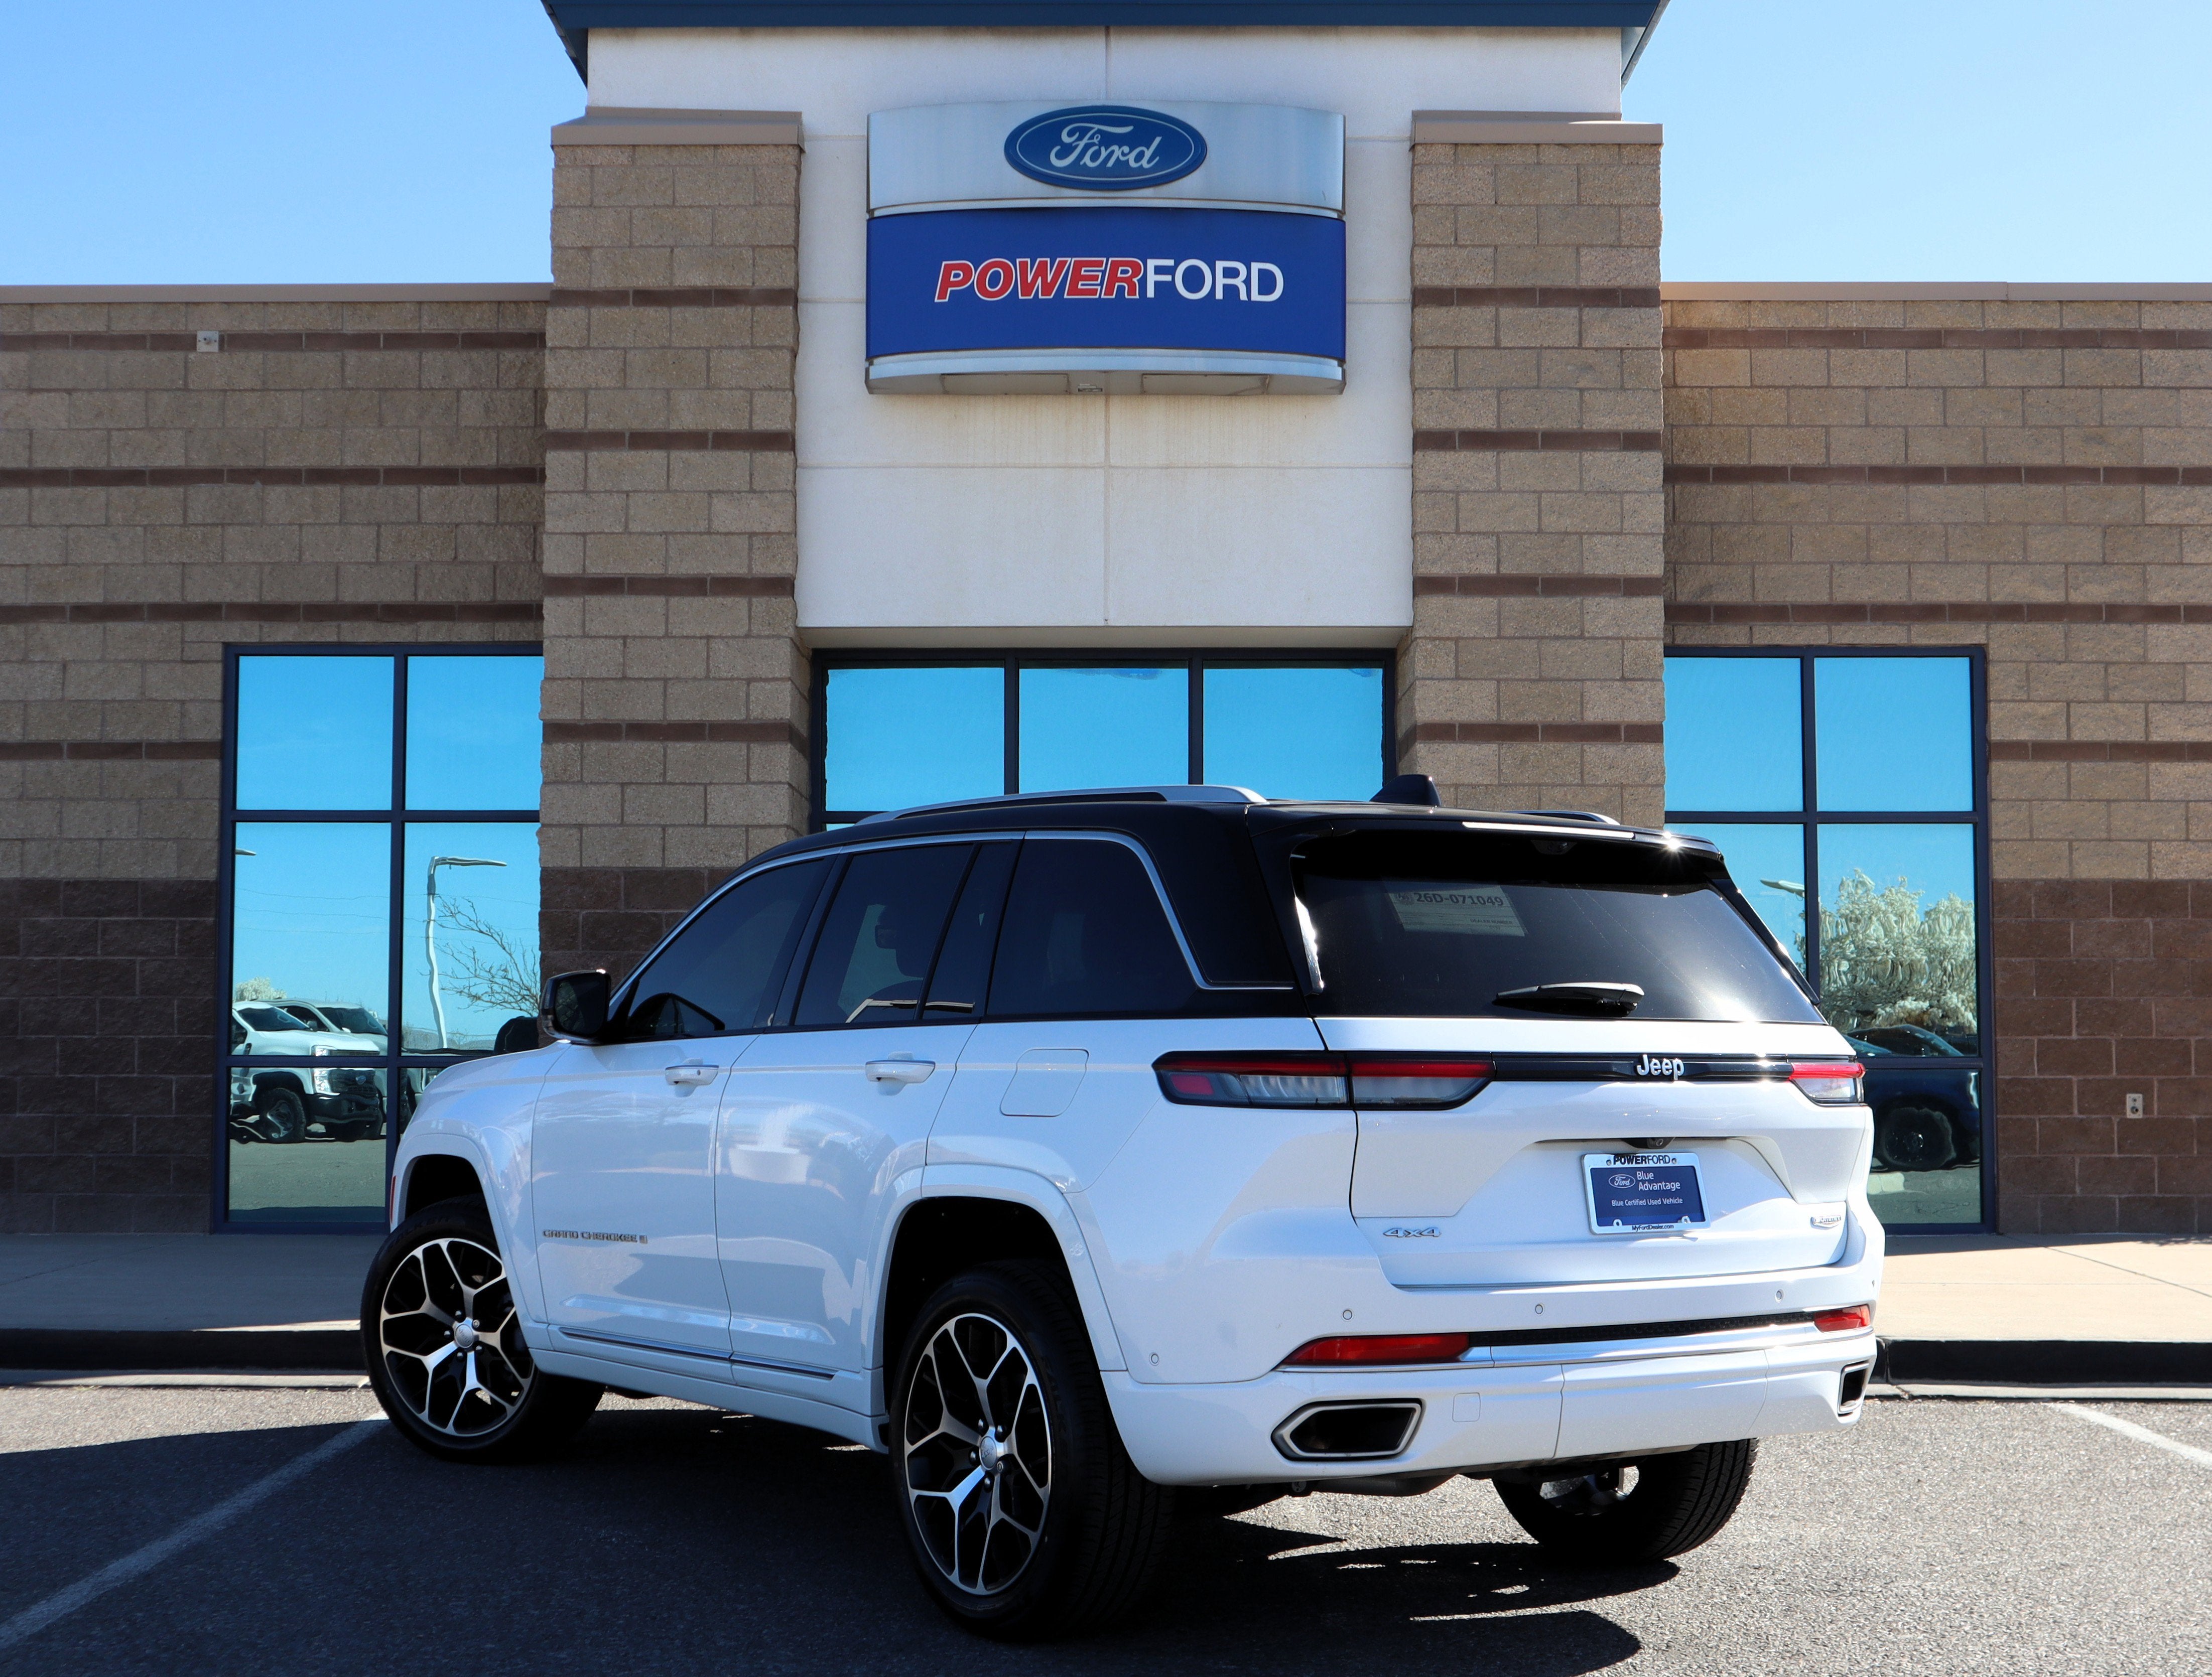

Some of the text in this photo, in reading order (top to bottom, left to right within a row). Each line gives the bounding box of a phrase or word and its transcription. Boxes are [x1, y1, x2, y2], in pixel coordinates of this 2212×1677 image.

[1049, 122, 1162, 169] Ford
[934, 257, 1284, 303] POWERFORD
[1413, 892, 1504, 906] 26D-071049
[1637, 1054, 1684, 1080] Jeep
[1613, 1155, 1670, 1165] POWERFORD
[1614, 1176, 1631, 1186] Ford
[1636, 1171, 1654, 1181] Blue
[1638, 1181, 1681, 1191] Advantage
[543, 1229, 638, 1243] GRAND CHEROKEE
[1383, 1227, 1442, 1238] 4x4
